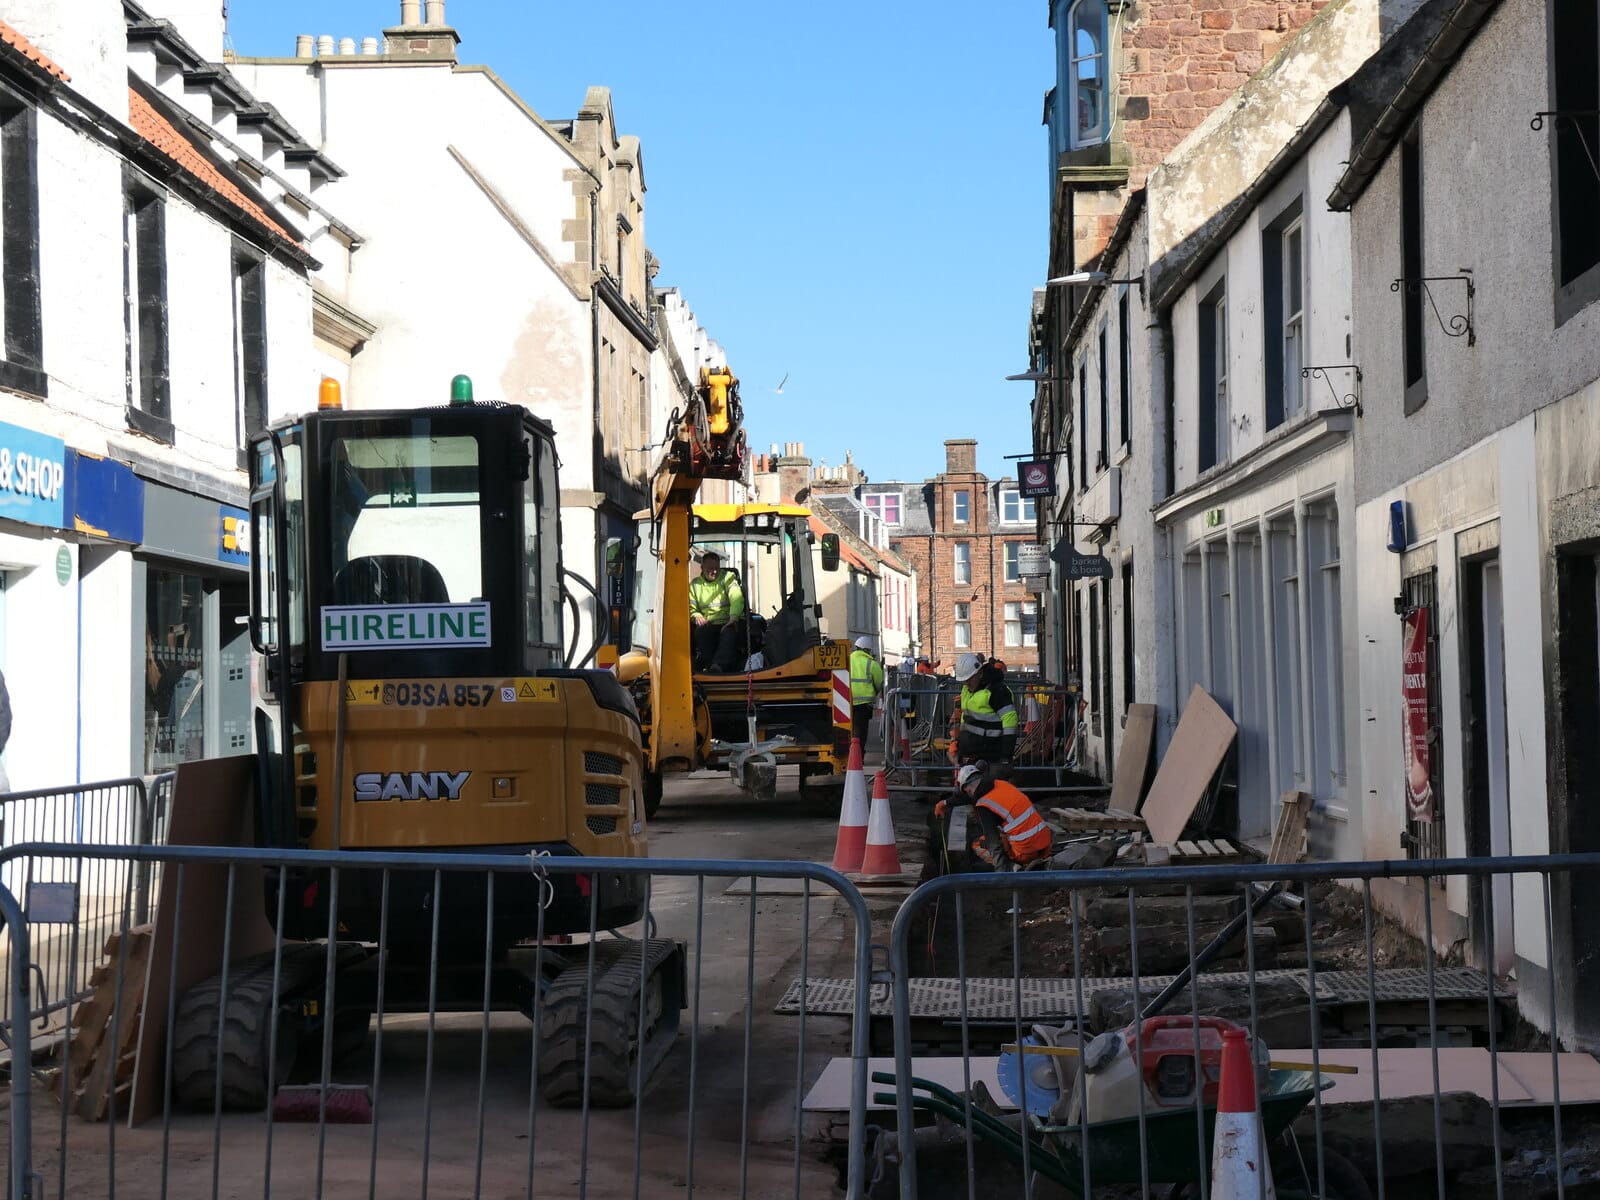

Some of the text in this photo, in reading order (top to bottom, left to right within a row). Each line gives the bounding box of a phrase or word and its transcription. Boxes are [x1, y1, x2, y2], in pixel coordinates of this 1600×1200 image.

[15, 451, 63, 501] SHOP
[1072, 557, 1101, 565] barker
[1071, 566, 1079, 574] &
[325, 612, 487, 641] HIRELINE
[818, 646, 841, 656] SD71
[820, 657, 840, 667] YJZ
[355, 772, 470, 801] SANY
